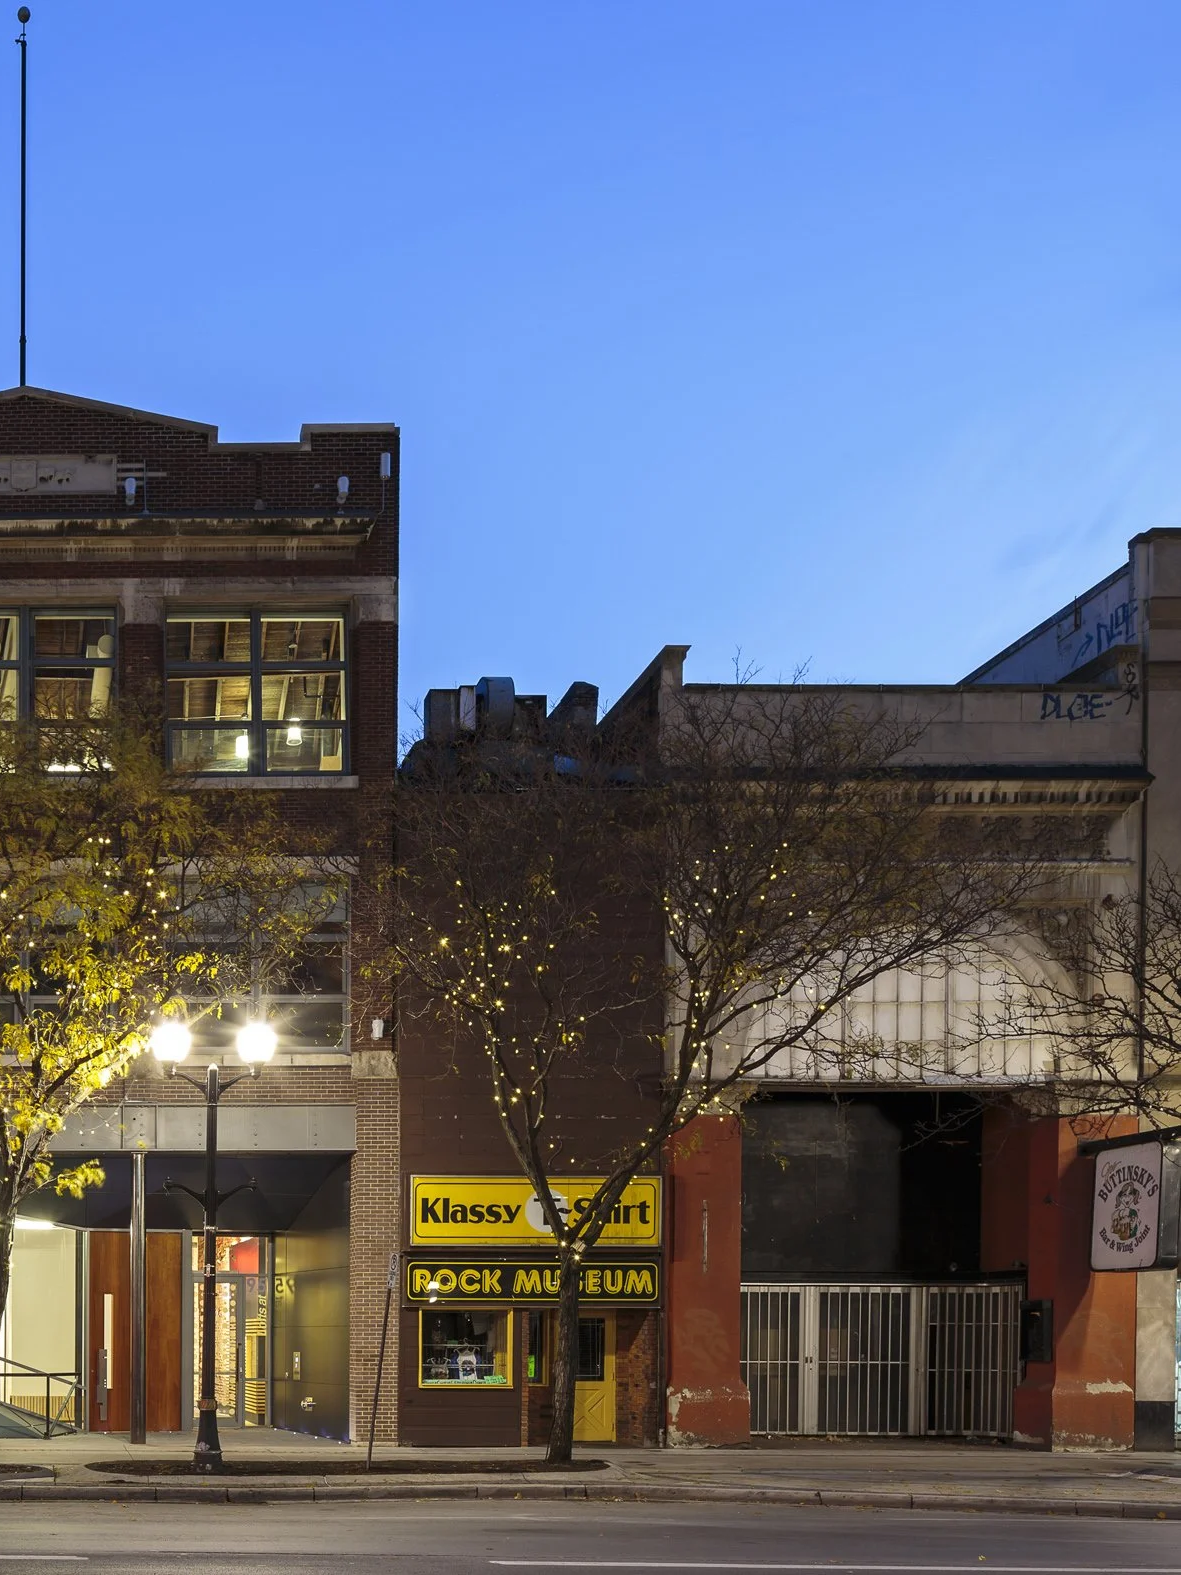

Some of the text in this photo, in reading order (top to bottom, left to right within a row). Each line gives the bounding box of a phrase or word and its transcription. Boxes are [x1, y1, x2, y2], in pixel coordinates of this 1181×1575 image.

[1098, 1165, 1159, 1202] BUTTINSKY'S
[421, 1198, 522, 1224] Klassy
[1099, 1227, 1111, 1245] Bar
[1116, 1241, 1134, 1254] Wing
[1134, 1224, 1151, 1247] Joint
[412, 1268, 654, 1294] ROCK MUEUM
